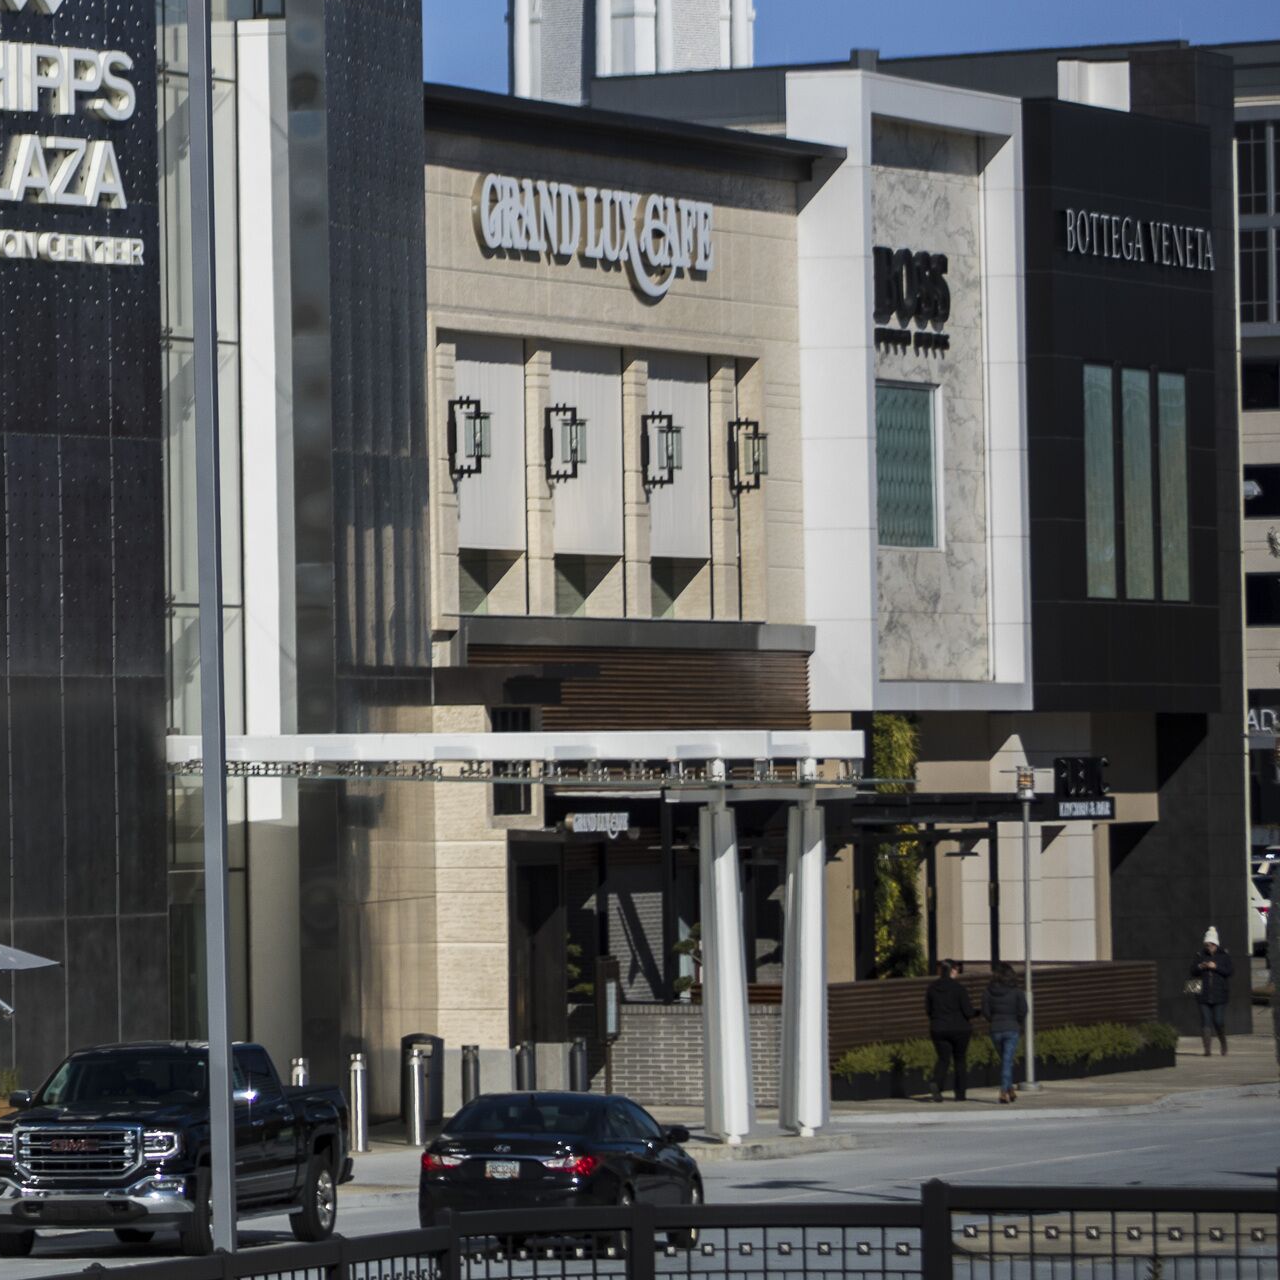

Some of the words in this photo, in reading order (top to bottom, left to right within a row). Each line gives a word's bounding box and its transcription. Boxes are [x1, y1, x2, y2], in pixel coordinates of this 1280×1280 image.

[40, 232, 144, 265] CENTER
[480, 173, 582, 255] GRAND
[584, 186, 662, 297] LUX
[1066, 208, 1145, 262] BOTTEGA
[1149, 221, 1215, 271] VENETA
